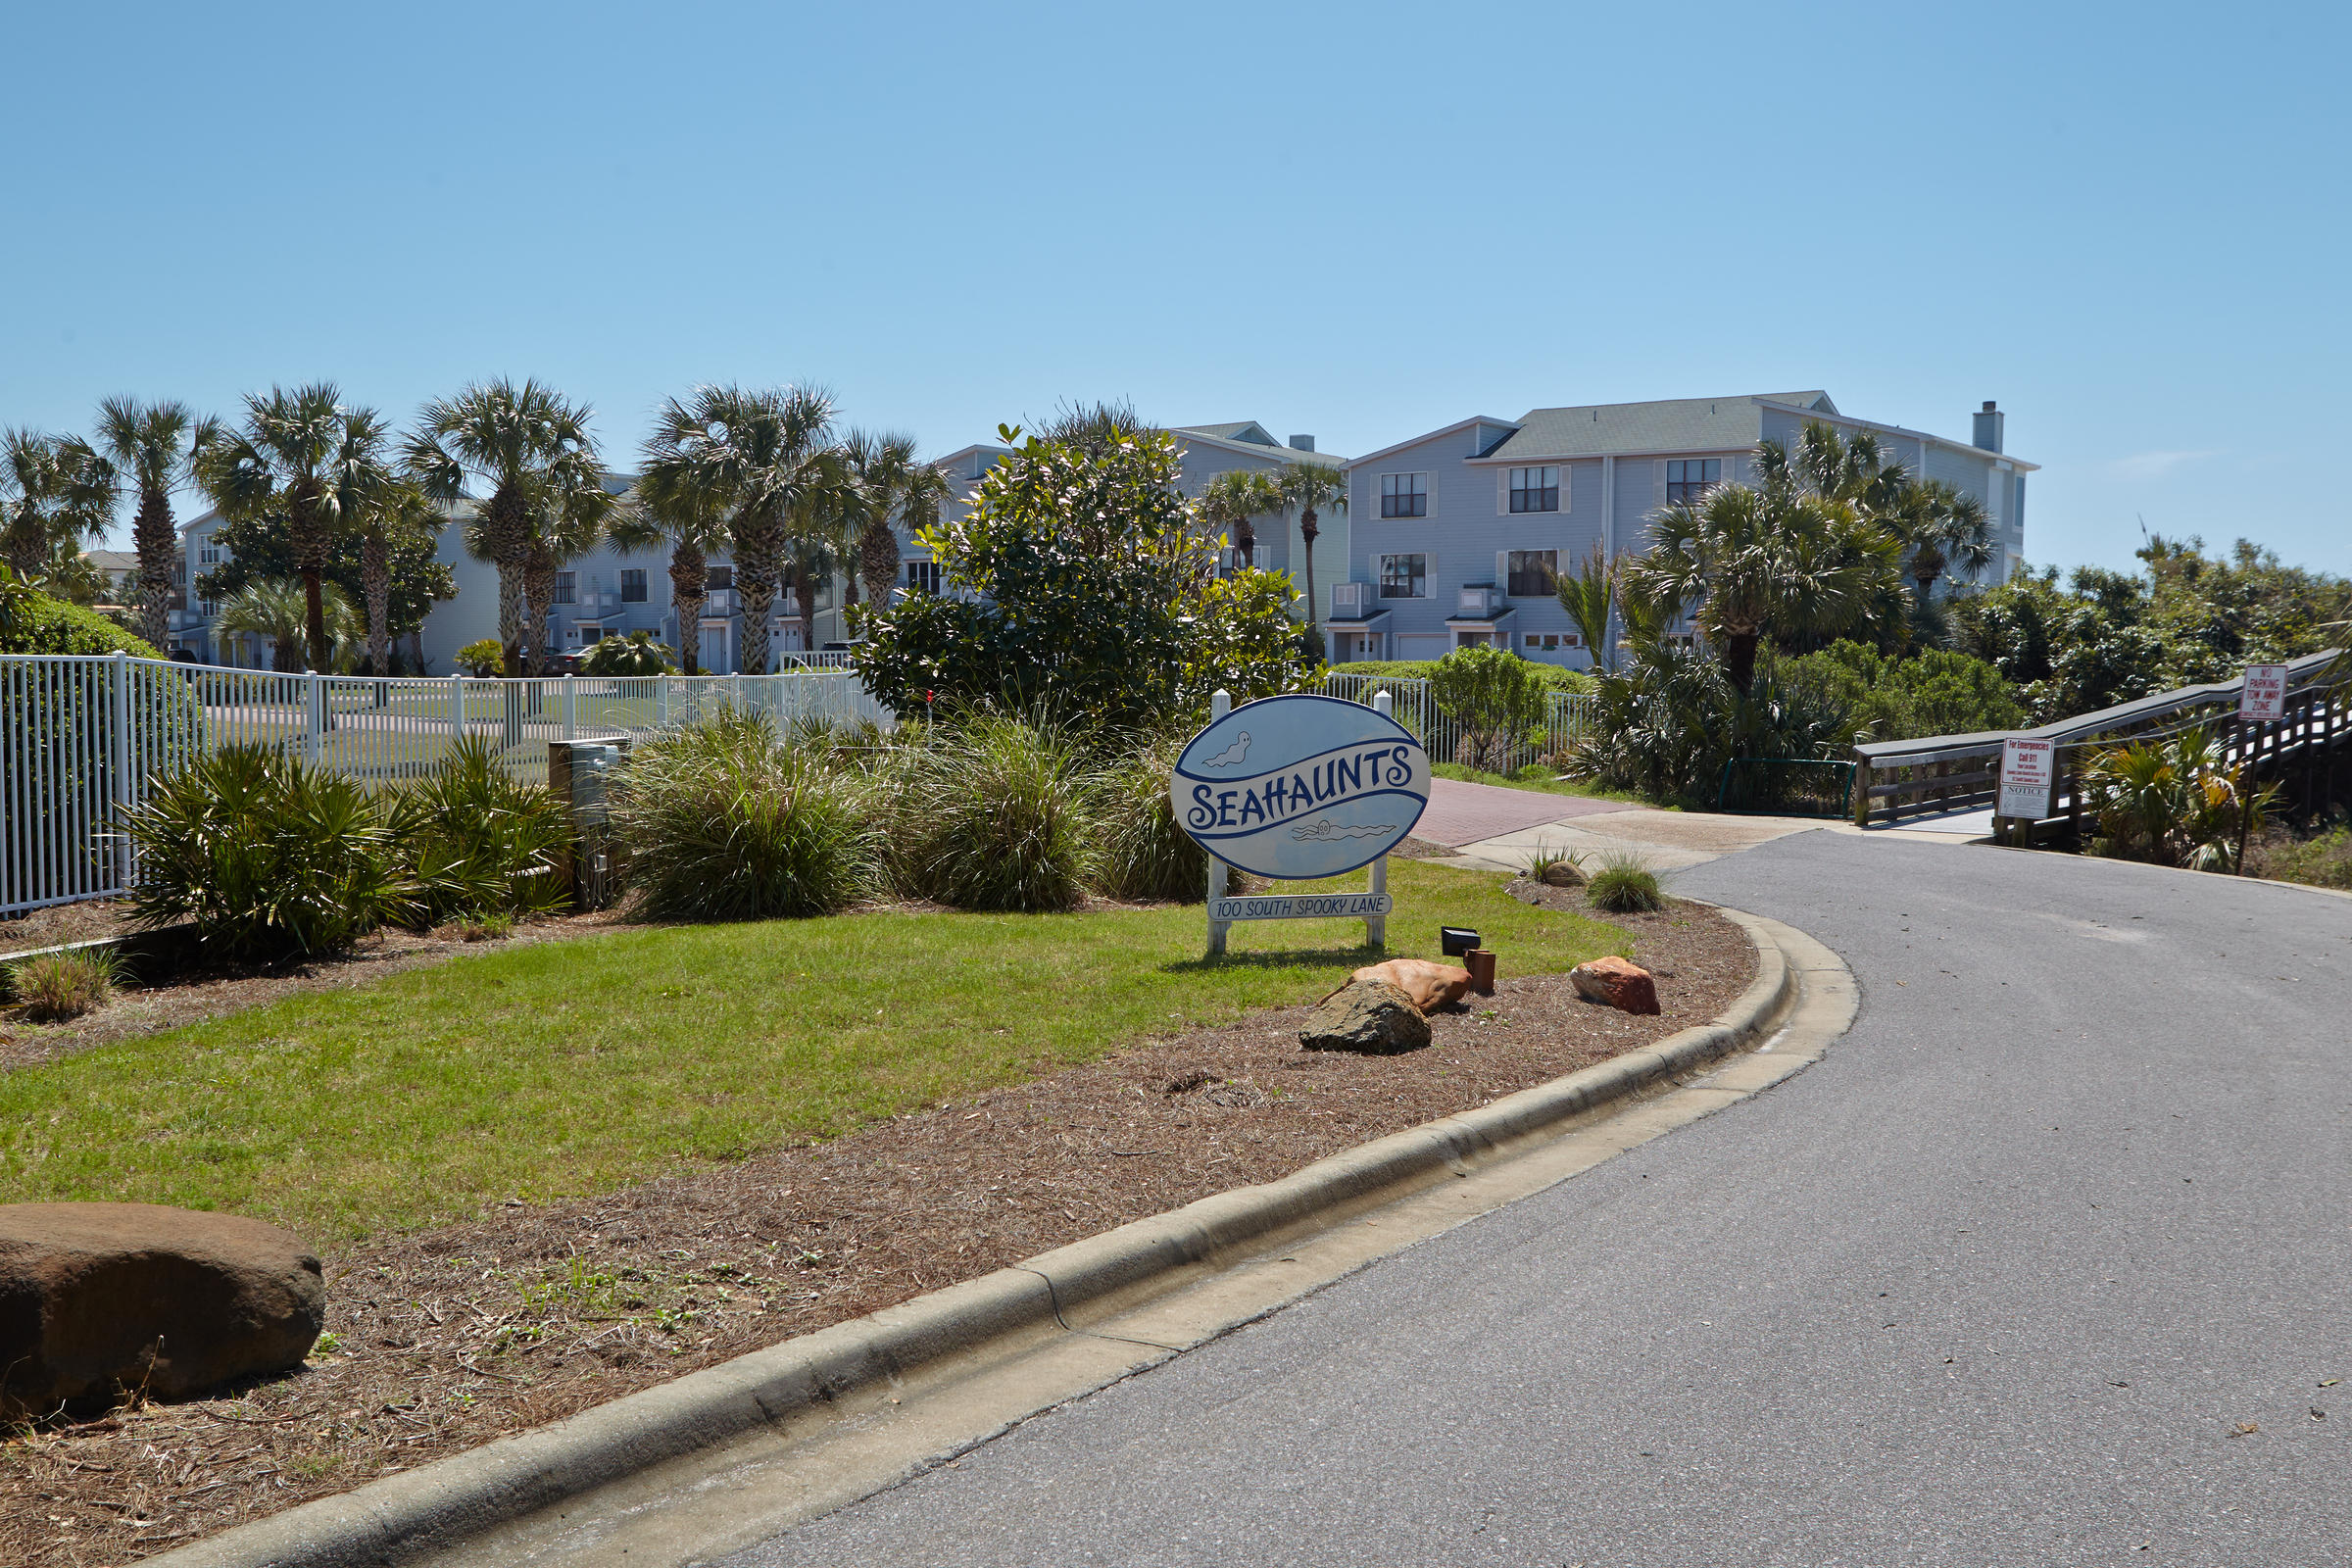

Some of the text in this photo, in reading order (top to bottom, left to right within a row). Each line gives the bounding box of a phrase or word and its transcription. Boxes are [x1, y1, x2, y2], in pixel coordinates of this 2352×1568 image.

[2260, 667, 2273, 677] NO
[2250, 678, 2279, 689] PARKING
[2247, 690, 2280, 700] TOW AWAY
[2253, 701, 2271, 710] ZONE
[2018, 741, 2049, 751] Emergencies
[2019, 753, 2029, 761] Call
[1187, 745, 1412, 830] SEAHAUNTS
[2008, 787, 2043, 796] NOTICE
[1217, 897, 1385, 917] 100 SOUTH SPOOKY LANE
